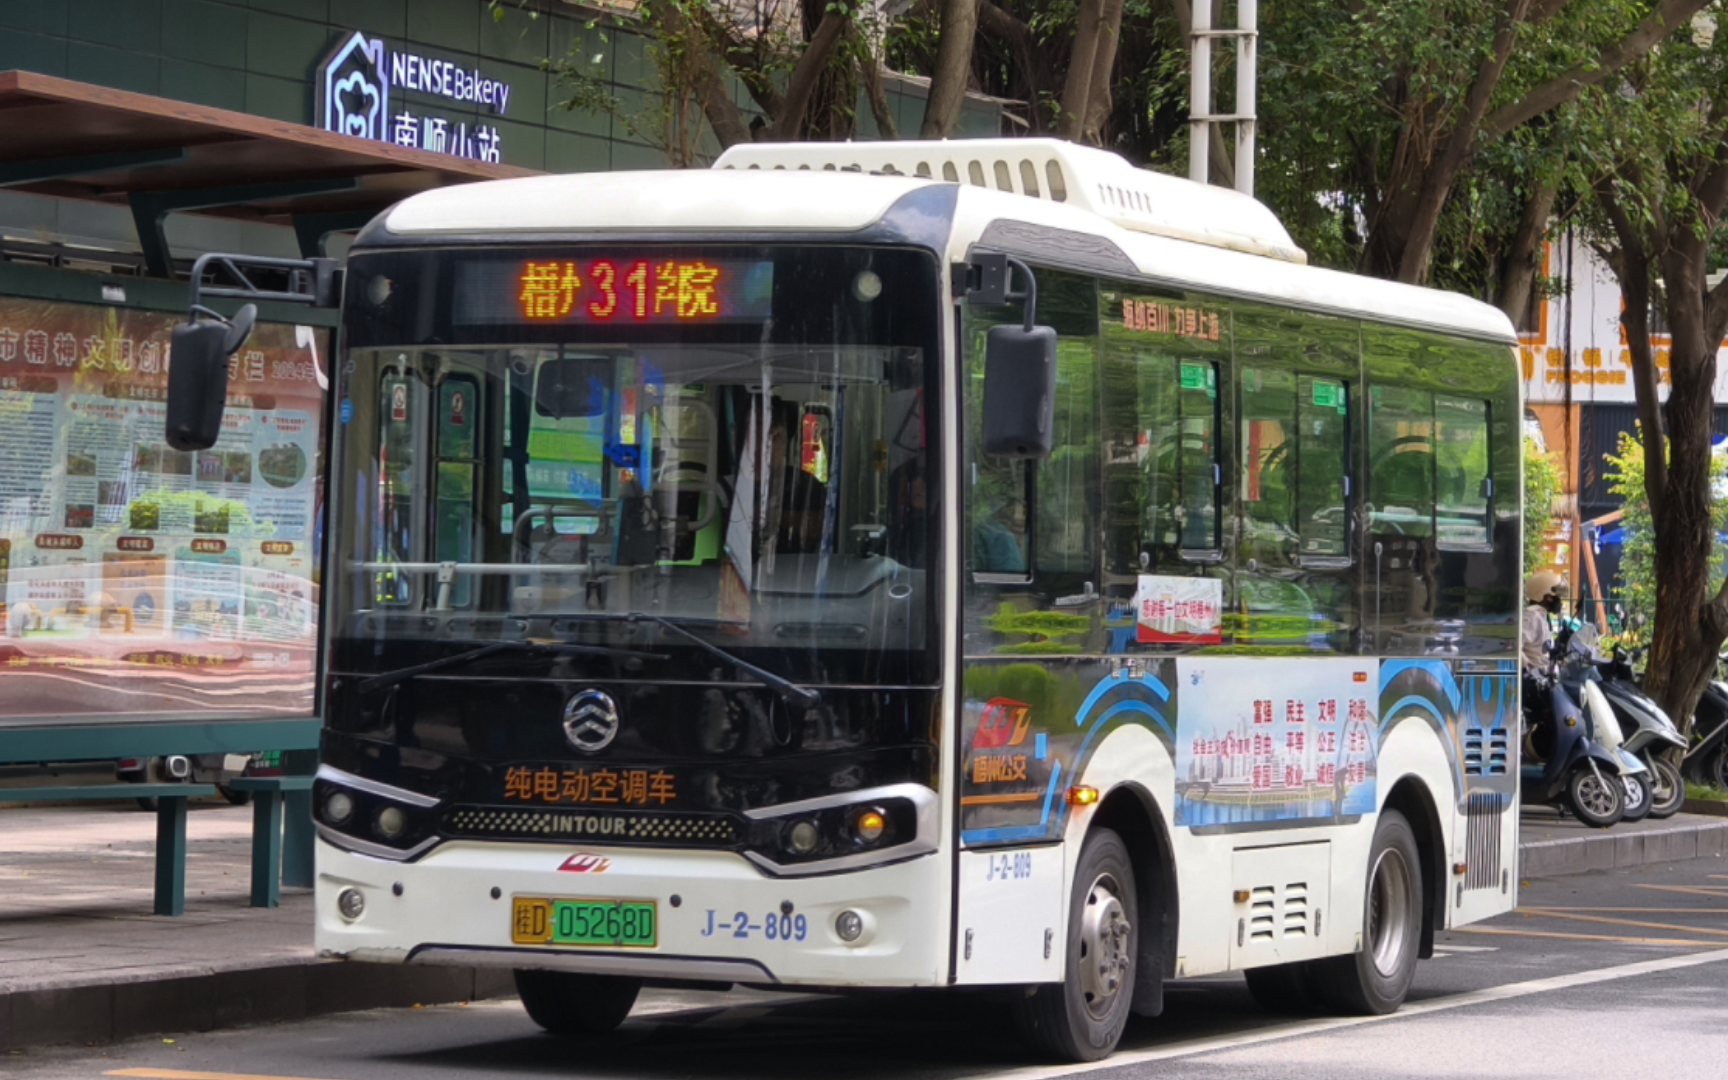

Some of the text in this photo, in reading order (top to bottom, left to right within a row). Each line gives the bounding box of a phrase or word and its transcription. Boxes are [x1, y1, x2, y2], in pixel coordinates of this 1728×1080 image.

[395, 111, 500, 164] 南顺小站
[1123, 299, 1170, 333] 海纳百川
[1253, 699, 1272, 723] 富强
[1286, 699, 1304, 722] 民主
[1318, 699, 1336, 722] 文明
[1254, 732, 1272, 755] 自由
[1286, 731, 1304, 754] 平等
[1318, 731, 1336, 753] 公正
[973, 754, 1027, 784] 梧州公交
[1253, 761, 1365, 788] 爱国 敬业 诚信 友善
[504, 765, 677, 804] 纯电动空调车
[552, 815, 627, 835] INTOUR
[987, 852, 1032, 881] J-2-809
[701, 908, 809, 942] J-2-809
